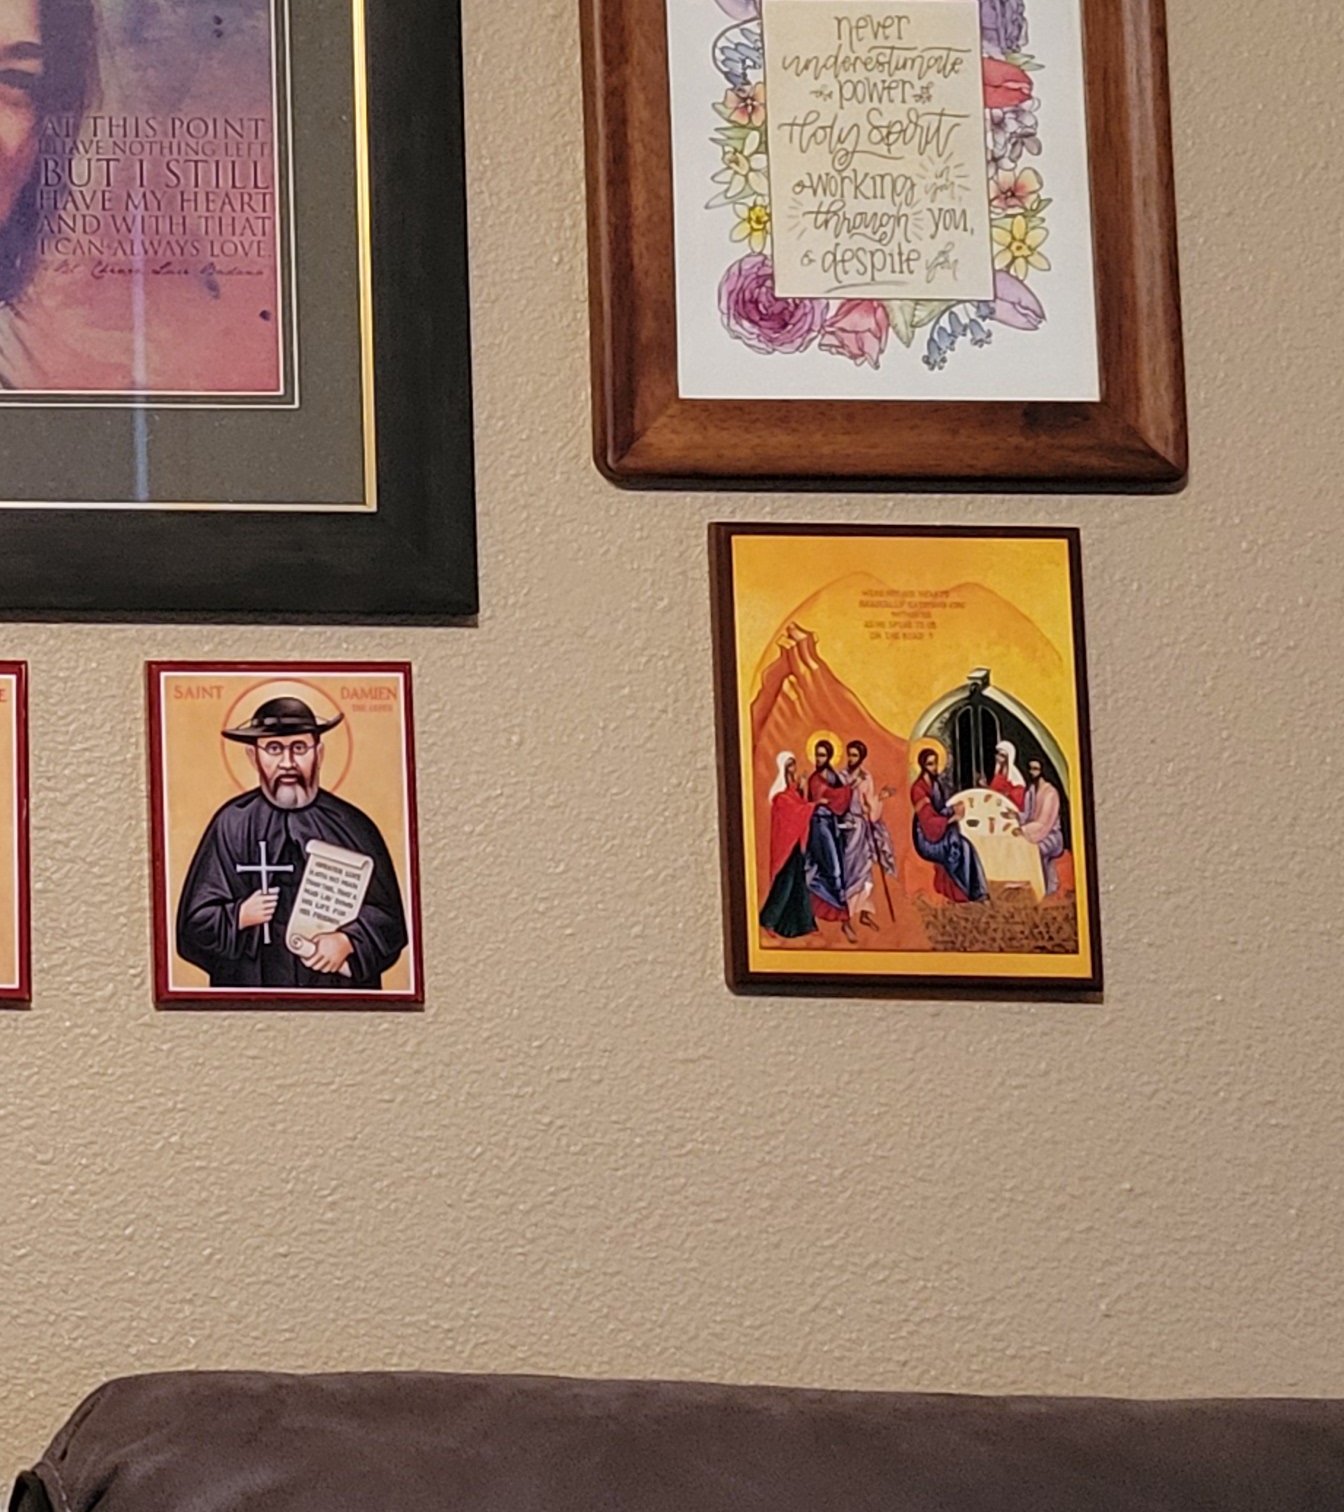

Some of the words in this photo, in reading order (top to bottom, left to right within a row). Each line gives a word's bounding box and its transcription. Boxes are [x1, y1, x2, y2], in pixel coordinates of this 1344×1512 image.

[834, 14, 911, 53] never
[782, 43, 972, 81] underestimate
[837, 77, 915, 110] power
[41, 116, 76, 138] AT
[88, 116, 158, 139] THIS
[170, 116, 267, 140] POINT
[777, 109, 880, 171] Holy
[867, 106, 971, 158] Spirit
[48, 139, 104, 156] HAVE
[112, 139, 217, 158] NOTHING
[224, 141, 269, 158] LEFT
[42, 157, 121, 188] BUT
[137, 159, 147, 188] I
[164, 158, 271, 190] STILL
[806, 168, 916, 207] working
[38, 190, 113, 212] HAVE
[125, 190, 170, 212] MY
[180, 190, 274, 214] HEART
[36, 213, 102, 235] AND
[111, 214, 188, 236] WITH
[199, 215, 272, 238] THAT
[802, 198, 912, 246] through
[54, 238, 105, 256] CAN
[111, 239, 201, 257] ALWAYS
[821, 241, 921, 284] despite
[173, 685, 224, 700] SAINT
[340, 685, 397, 701] DAMIEN
